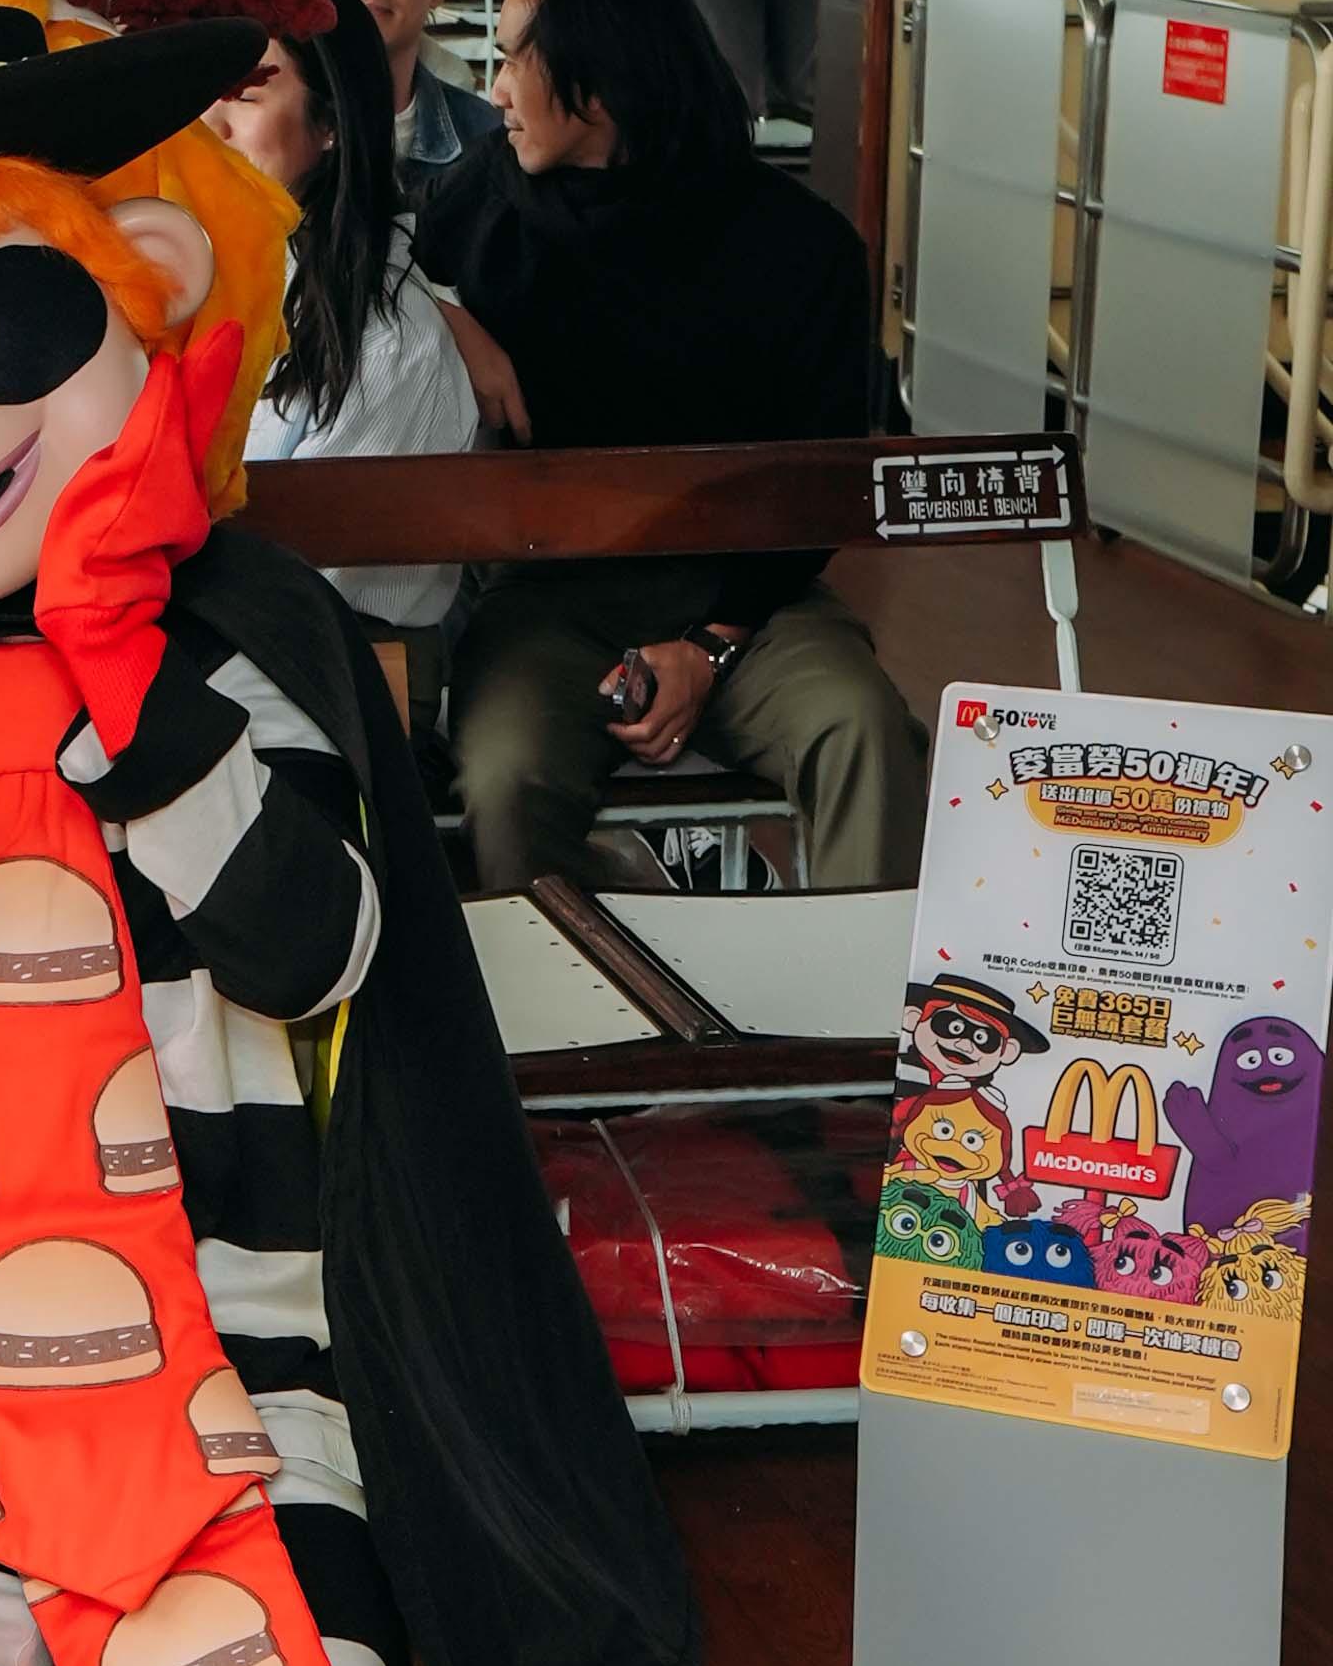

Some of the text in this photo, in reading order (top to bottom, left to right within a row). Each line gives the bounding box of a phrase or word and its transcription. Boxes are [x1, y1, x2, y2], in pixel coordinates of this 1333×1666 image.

[899, 464, 1041, 499] 雙向椅背
[908, 496, 1037, 520] REVERSIBLE BENCH
[993, 708, 1020, 726] 50
[1054, 984, 1172, 1019] 免費365日
[1033, 1150, 1158, 1185] McDonald's
